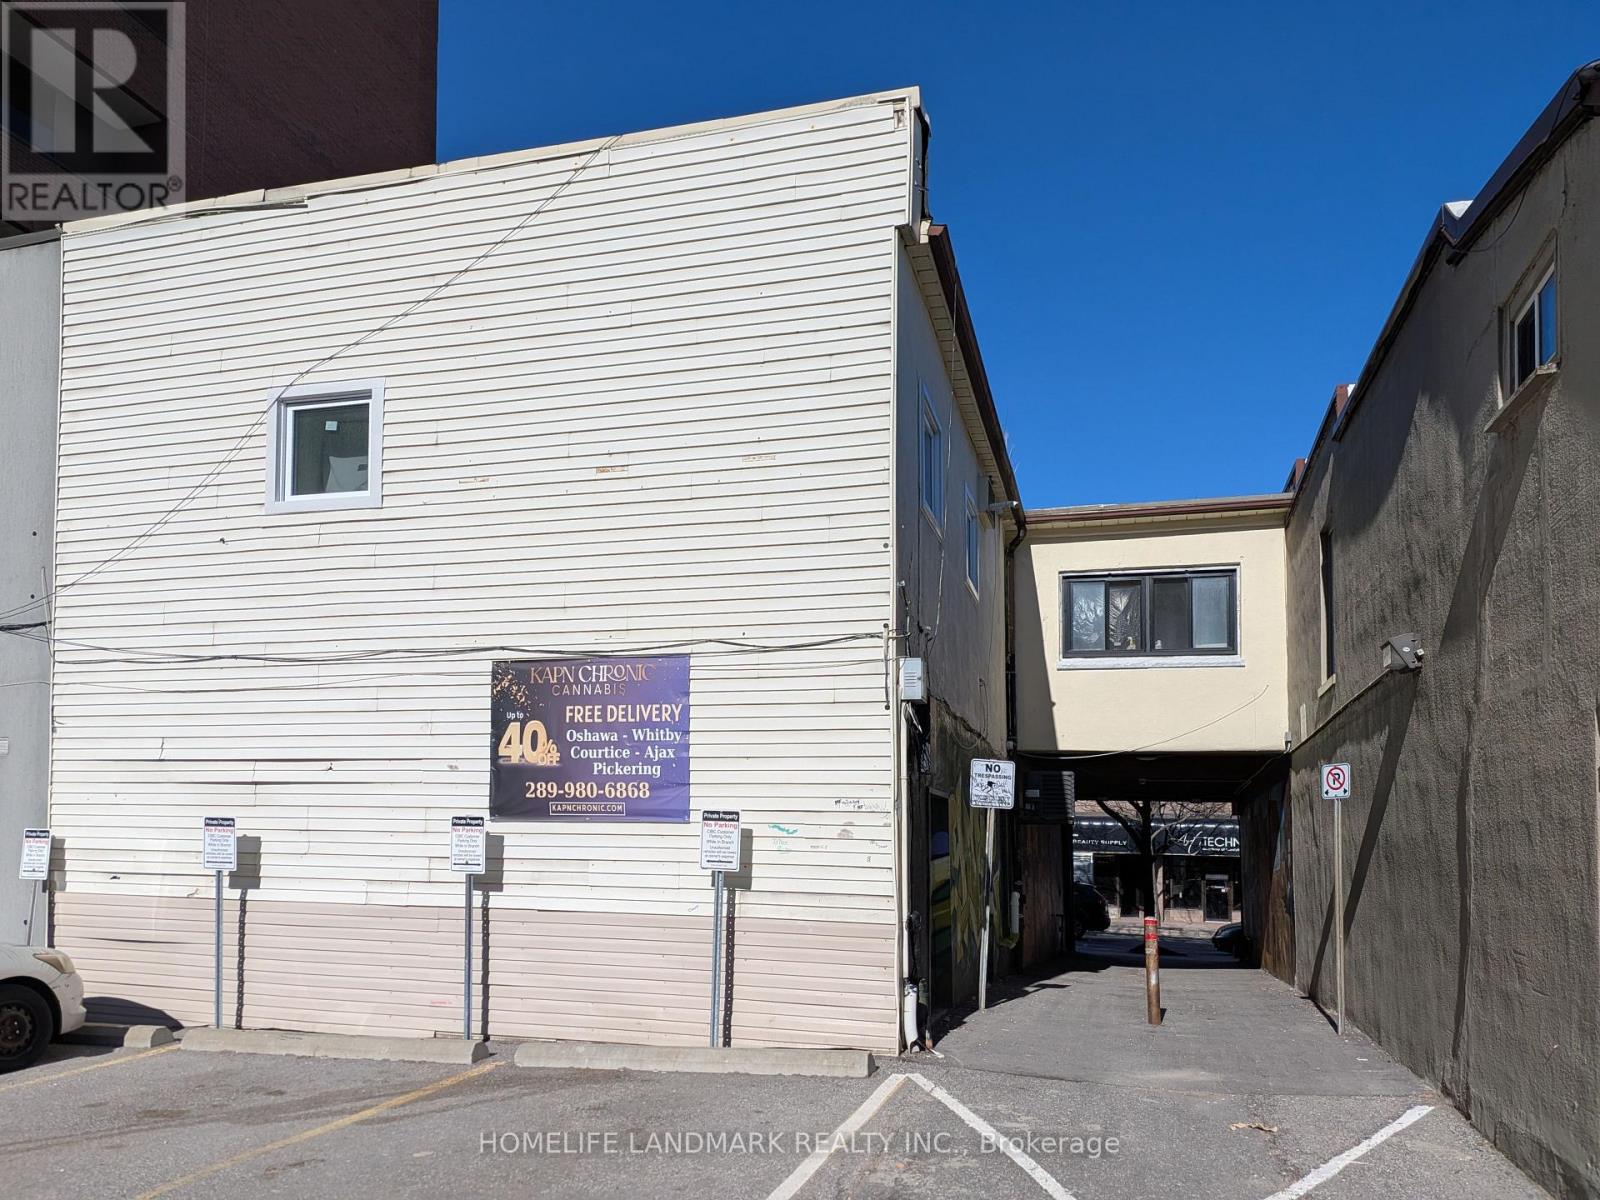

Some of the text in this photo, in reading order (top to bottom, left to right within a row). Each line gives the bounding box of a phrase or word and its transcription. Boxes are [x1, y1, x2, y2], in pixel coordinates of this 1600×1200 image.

[530, 664, 656, 684] KAPN CHRONIC
[552, 683, 626, 696] CANNABIS
[506, 711, 524, 720] Up to
[565, 704, 682, 723] FREE DELIVERY
[566, 729, 618, 742] Oshawa
[632, 728, 682, 742] Whitby
[570, 746, 630, 759] Courtice
[644, 746, 676, 762] Ajax
[593, 763, 661, 778] Pickering
[985, 764, 1001, 773] NO
[525, 781, 650, 799] 289-980-6868
[551, 804, 623, 812] KAPNCHRONIC.COM
[714, 822, 737, 830] Parking
